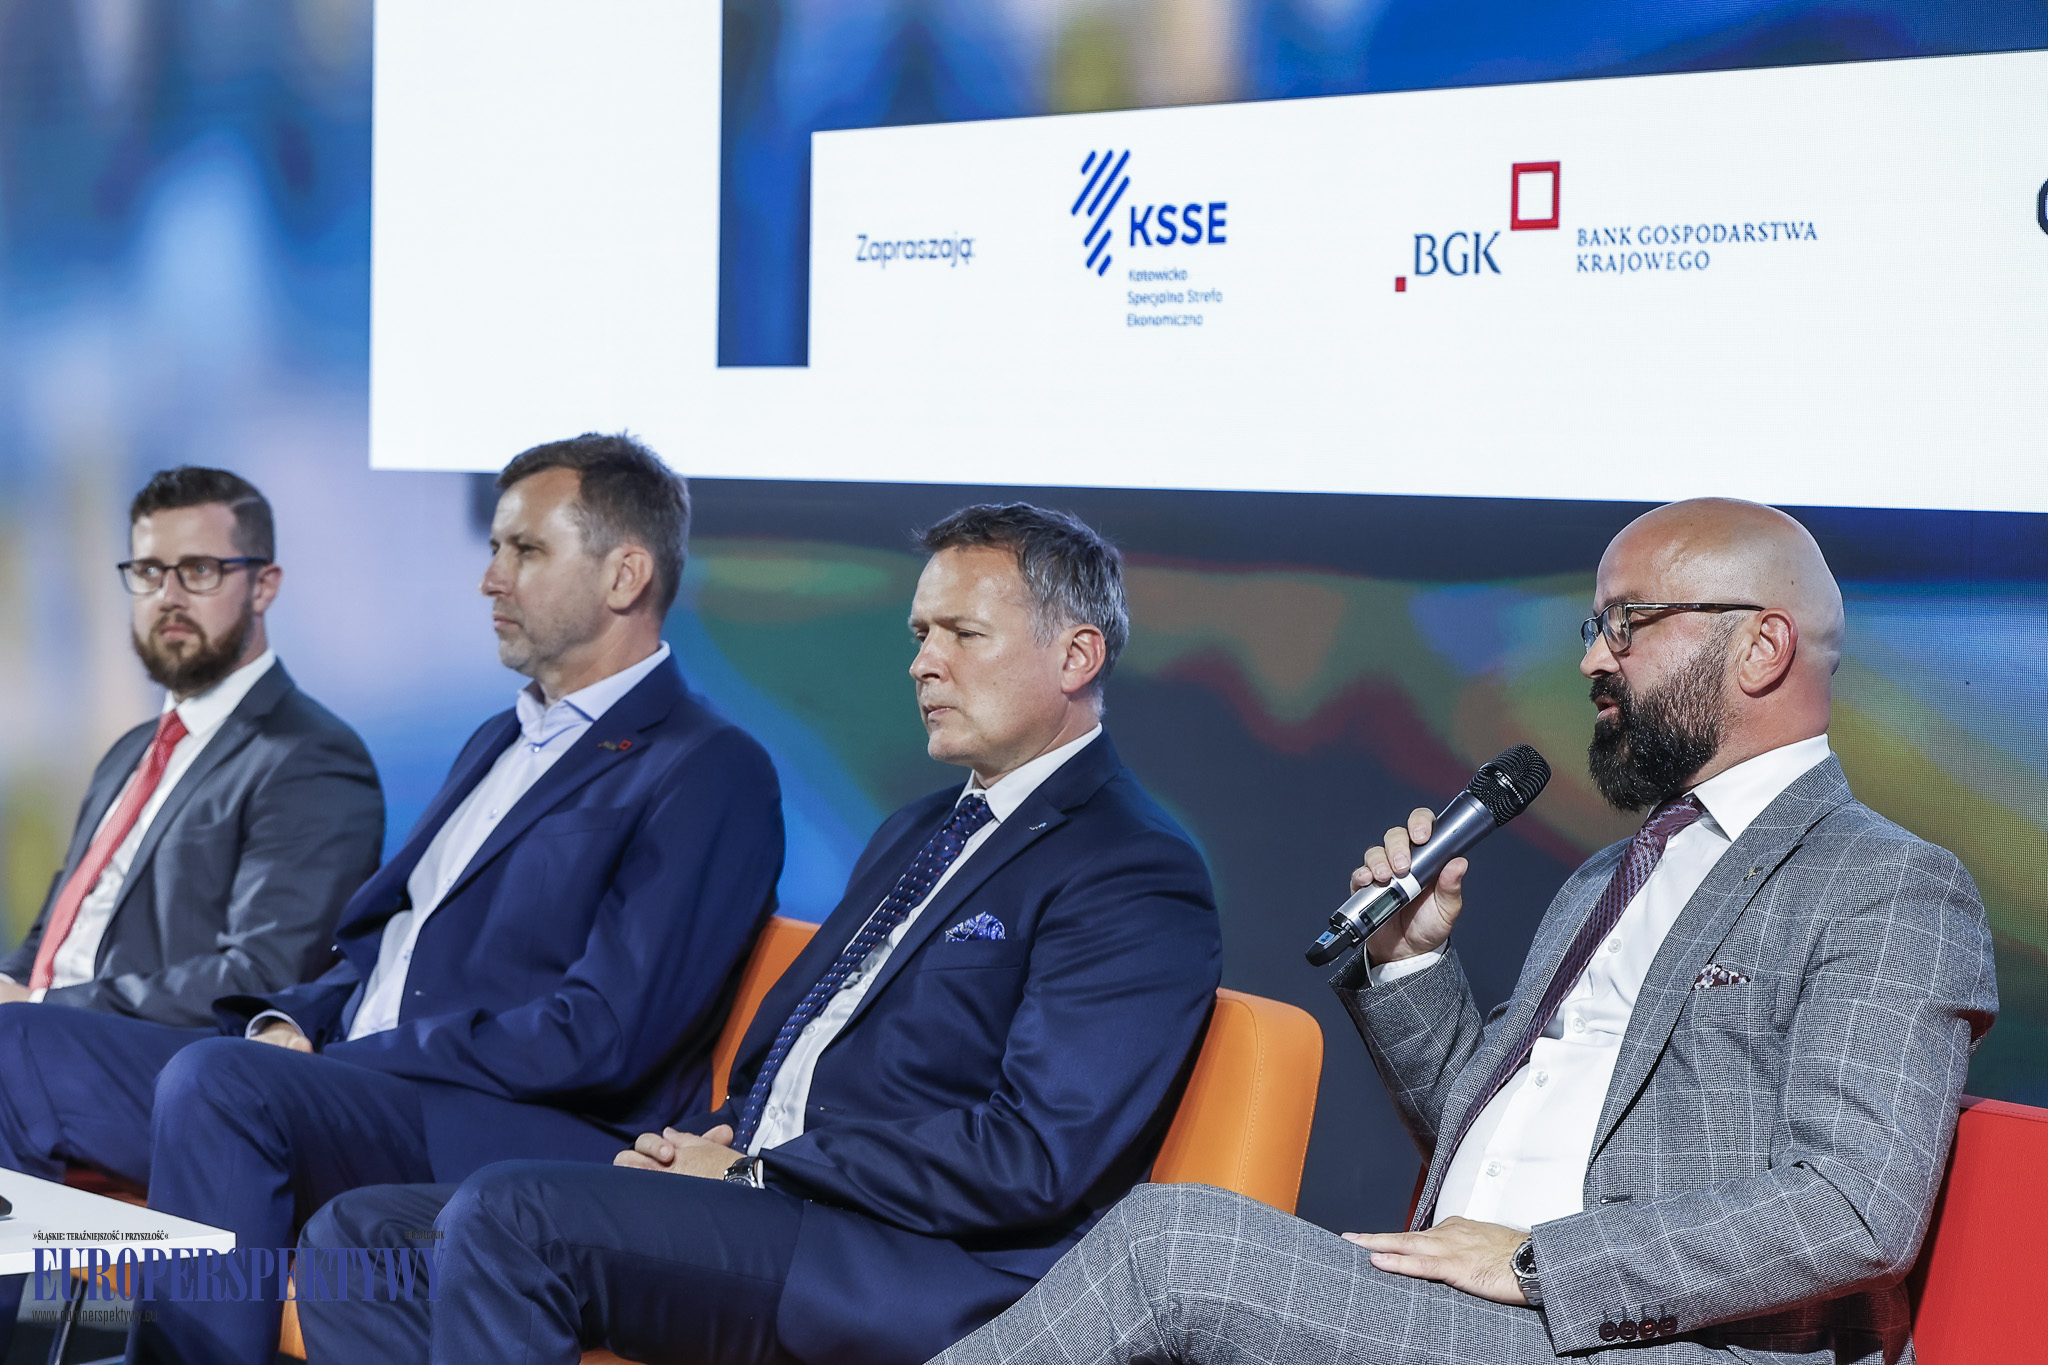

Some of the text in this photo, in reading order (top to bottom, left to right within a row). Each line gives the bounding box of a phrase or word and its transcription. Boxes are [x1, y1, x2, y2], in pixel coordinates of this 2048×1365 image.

[1129, 201, 1228, 246] KSSE
[1577, 220, 1818, 247] BANK GOSPODARSTWA
[1413, 231, 1502, 276] BGK
[1576, 250, 1710, 274] KRAJOWEGO
[1128, 268, 1188, 282] Katowicka
[1127, 289, 1223, 308] Specjalna Strefa
[1126, 313, 1204, 327] Ekonomiczna
